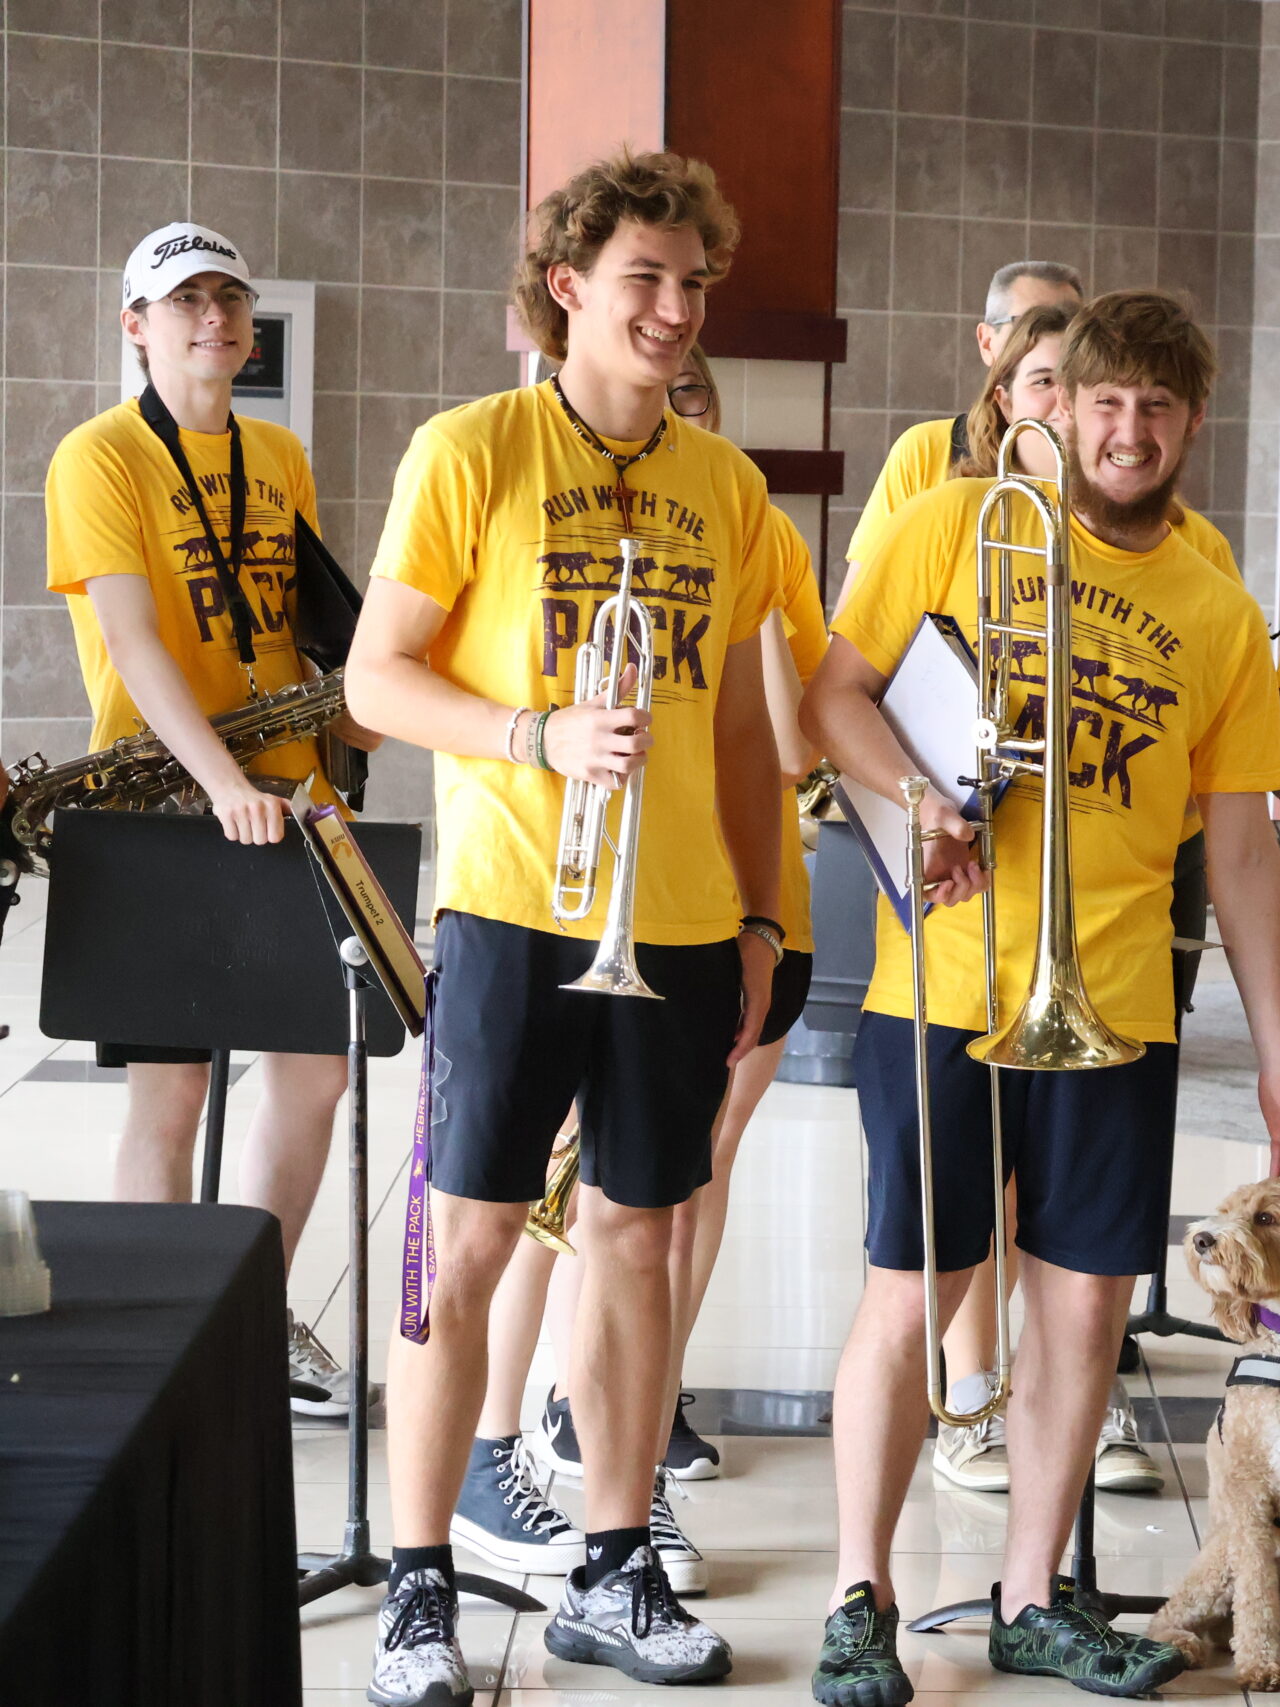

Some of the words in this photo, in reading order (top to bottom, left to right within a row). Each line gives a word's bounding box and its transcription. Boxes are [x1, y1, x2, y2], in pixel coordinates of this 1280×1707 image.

[150, 234, 237, 270] Titleist
[170, 485, 201, 516] RU
[254, 478, 286, 513] THE
[542, 486, 590, 526] RUN
[665, 498, 705, 542] THE
[1136, 611, 1183, 662] THE
[991, 688, 1160, 810] ACK
[355, 879, 380, 919] Trumpet
[375, 918, 385, 926] 2
[407, 1194, 422, 1233] PACK
[406, 1236, 420, 1267] THE
[405, 1269, 419, 1308] WITH
